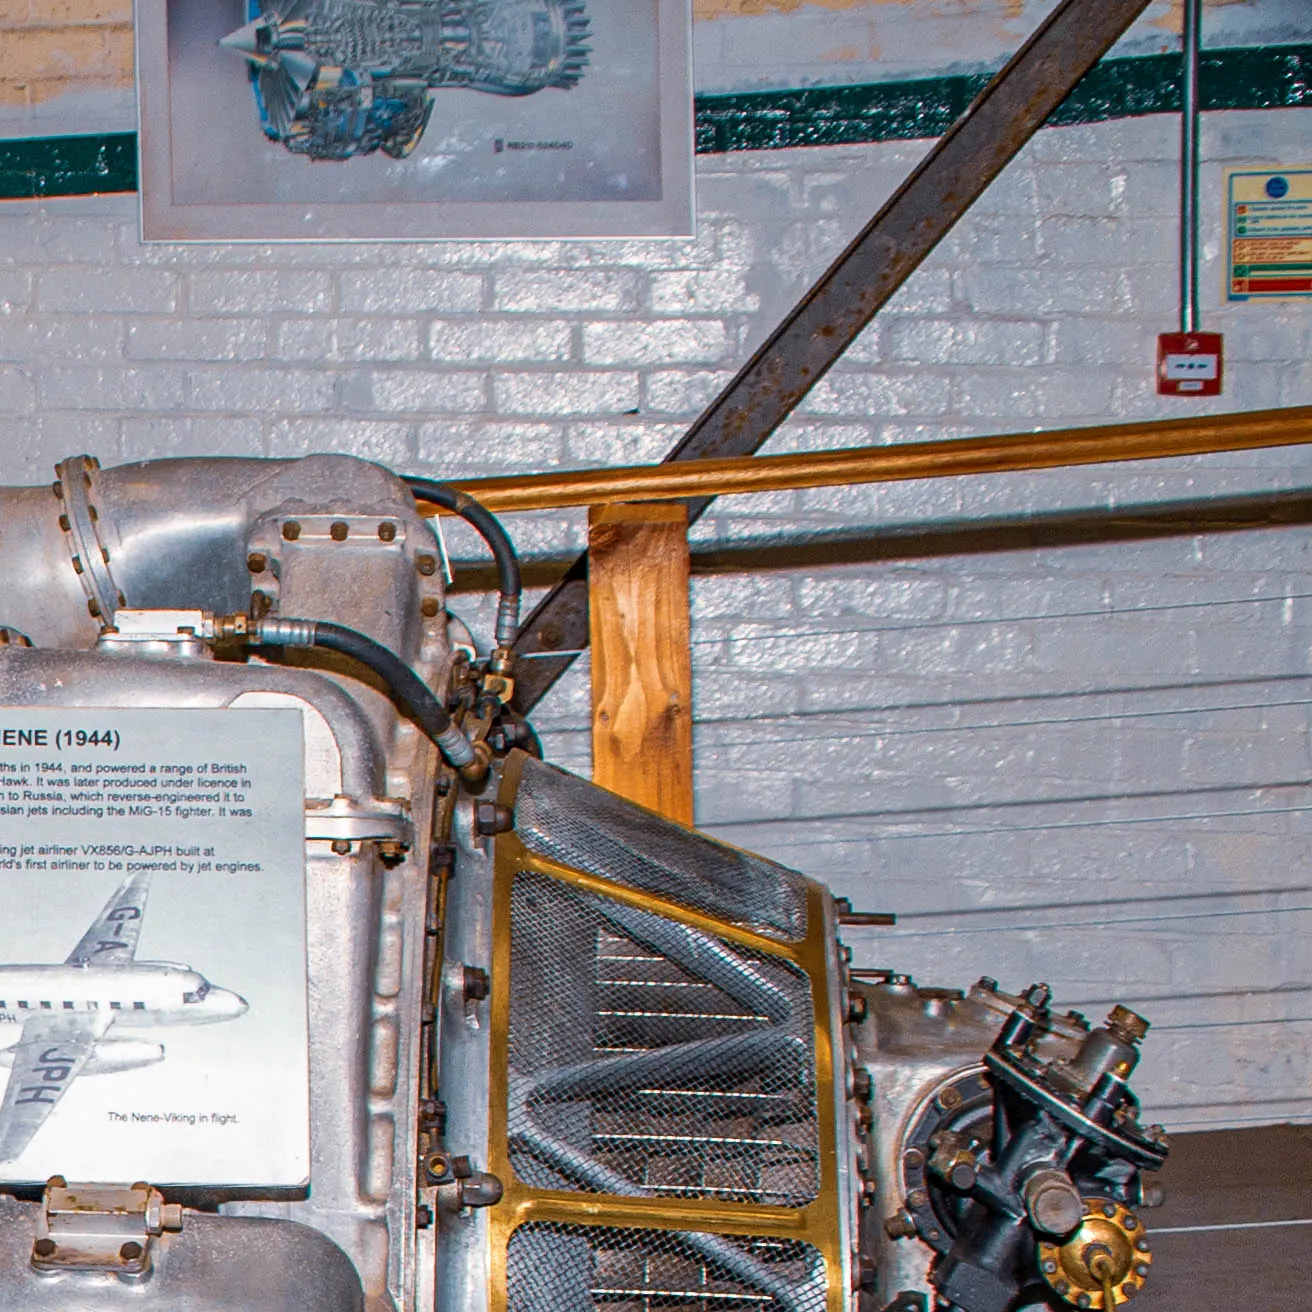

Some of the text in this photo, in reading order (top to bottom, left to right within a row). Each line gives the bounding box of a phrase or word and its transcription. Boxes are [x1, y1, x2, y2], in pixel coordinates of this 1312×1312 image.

[55, 729, 120, 750] (1944)
[19, 762, 31, 772] in
[34, 762, 66, 772] 1944,
[70, 763, 93, 772] and
[95, 763, 146, 774] powered
[148, 765, 157, 773] a
[159, 765, 194, 776] range
[196, 763, 208, 773] of
[210, 762, 247, 773] British
[36, 776, 44, 786] It
[46, 778, 70, 786] was
[73, 777, 100, 787] later
[102, 776, 158, 789] produced
[160, 777, 194, 787] under
[196, 777, 238, 788] licence
[240, 778, 252, 788] in
[7, 791, 20, 800] to
[69, 791, 104, 801] which
[107, 791, 220, 804] reverse-engineered
[223, 792, 231, 801] it
[232, 792, 245, 802] to
[26, 805, 48, 817] jets
[51, 805, 104, 818] including
[106, 805, 126, 816] the
[128, 805, 172, 816] MiG-15
[174, 805, 214, 819] fighter.
[218, 806, 226, 816] It
[228, 808, 253, 817] was
[19, 844, 35, 857] jet
[37, 844, 78, 855] airliner
[80, 844, 173, 856] VX856/G-AJPH
[175, 845, 201, 856] built
[202, 847, 215, 856] at
[25, 858, 47, 869] first
[50, 859, 91, 870] airliner
[93, 860, 105, 870] to
[107, 860, 123, 870] be
[126, 859, 177, 872] powered
[179, 861, 195, 873] by
[196, 861, 212, 873] jet
[214, 861, 264, 874] engines.
[15, 1048, 76, 1105] JPH
[107, 1111, 128, 1121] The
[131, 1112, 196, 1125] Nene-Viking
